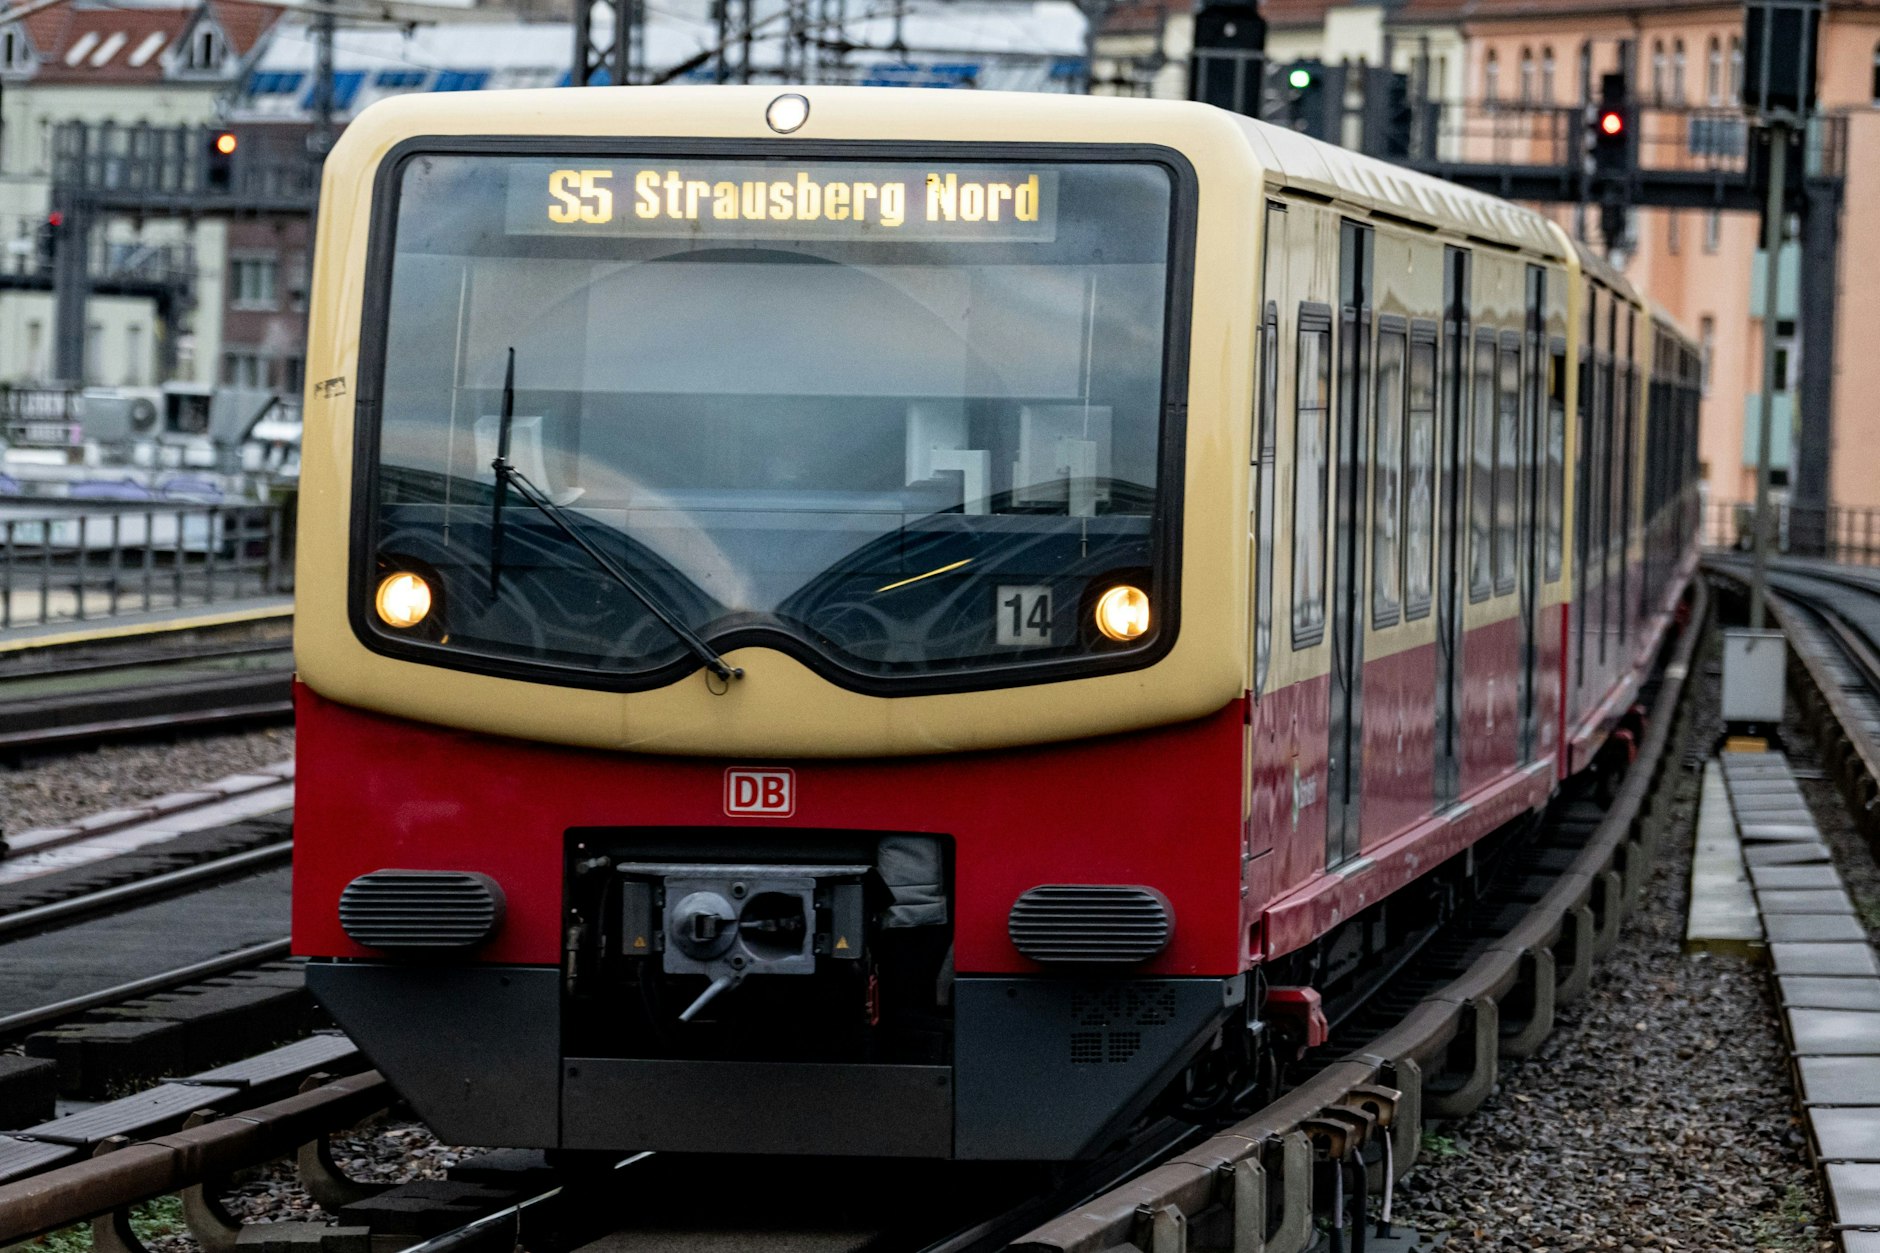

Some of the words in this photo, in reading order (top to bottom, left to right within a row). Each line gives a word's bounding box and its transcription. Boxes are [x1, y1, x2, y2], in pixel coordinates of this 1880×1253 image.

[548, 169, 613, 224] S5
[635, 169, 905, 227] Strausberg
[926, 172, 1039, 222] Nord
[1004, 593, 1053, 638] 14
[734, 775, 786, 809] DB
